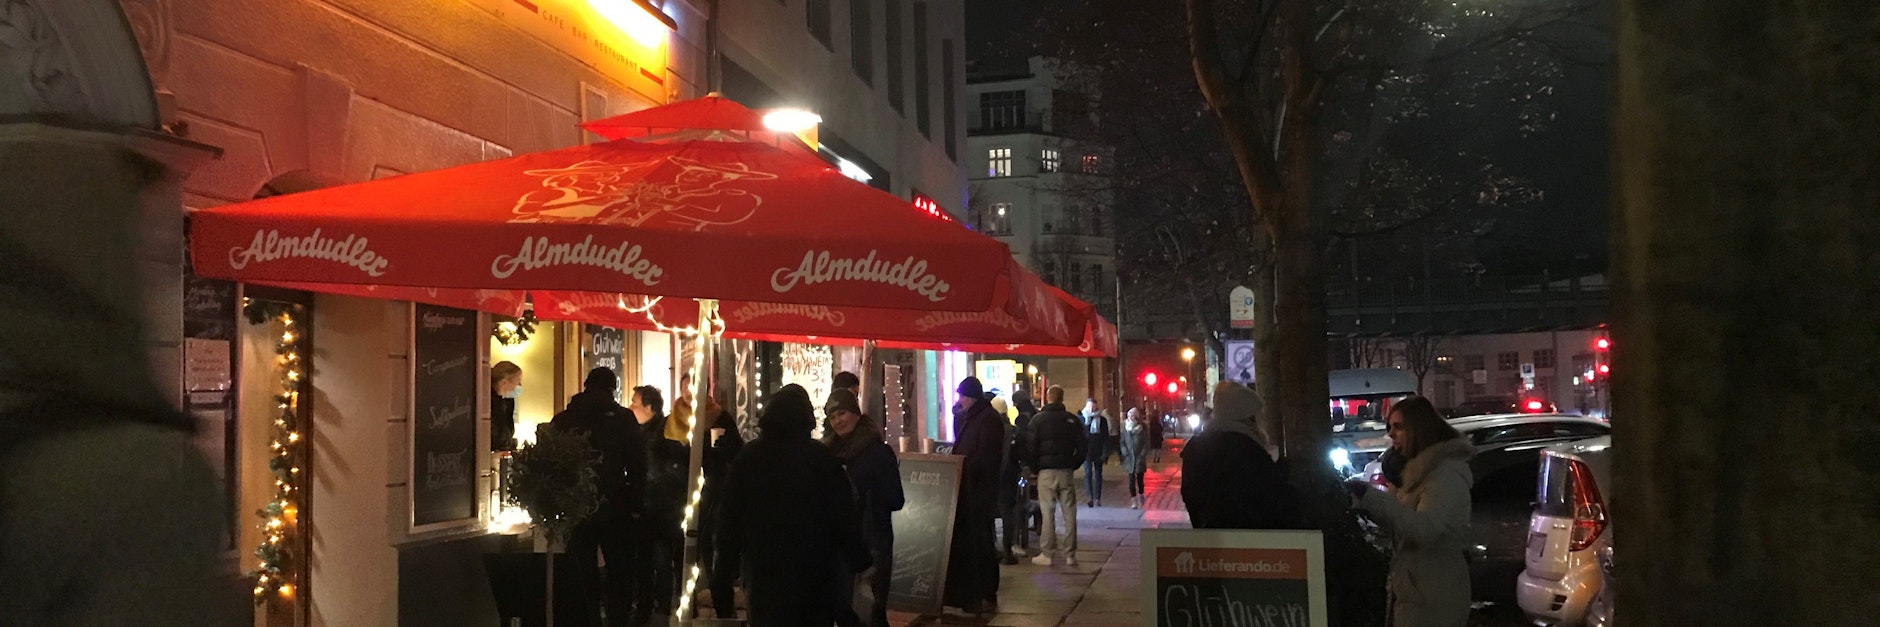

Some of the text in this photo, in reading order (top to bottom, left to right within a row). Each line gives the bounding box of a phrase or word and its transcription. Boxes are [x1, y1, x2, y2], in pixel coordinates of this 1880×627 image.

[594, 39, 638, 73] RESTAURANT
[228, 228, 389, 278] Almdudler
[491, 234, 664, 287] Almdudler
[770, 248, 950, 302] Almdudler
[1199, 558, 1290, 574] Lieferando.de
